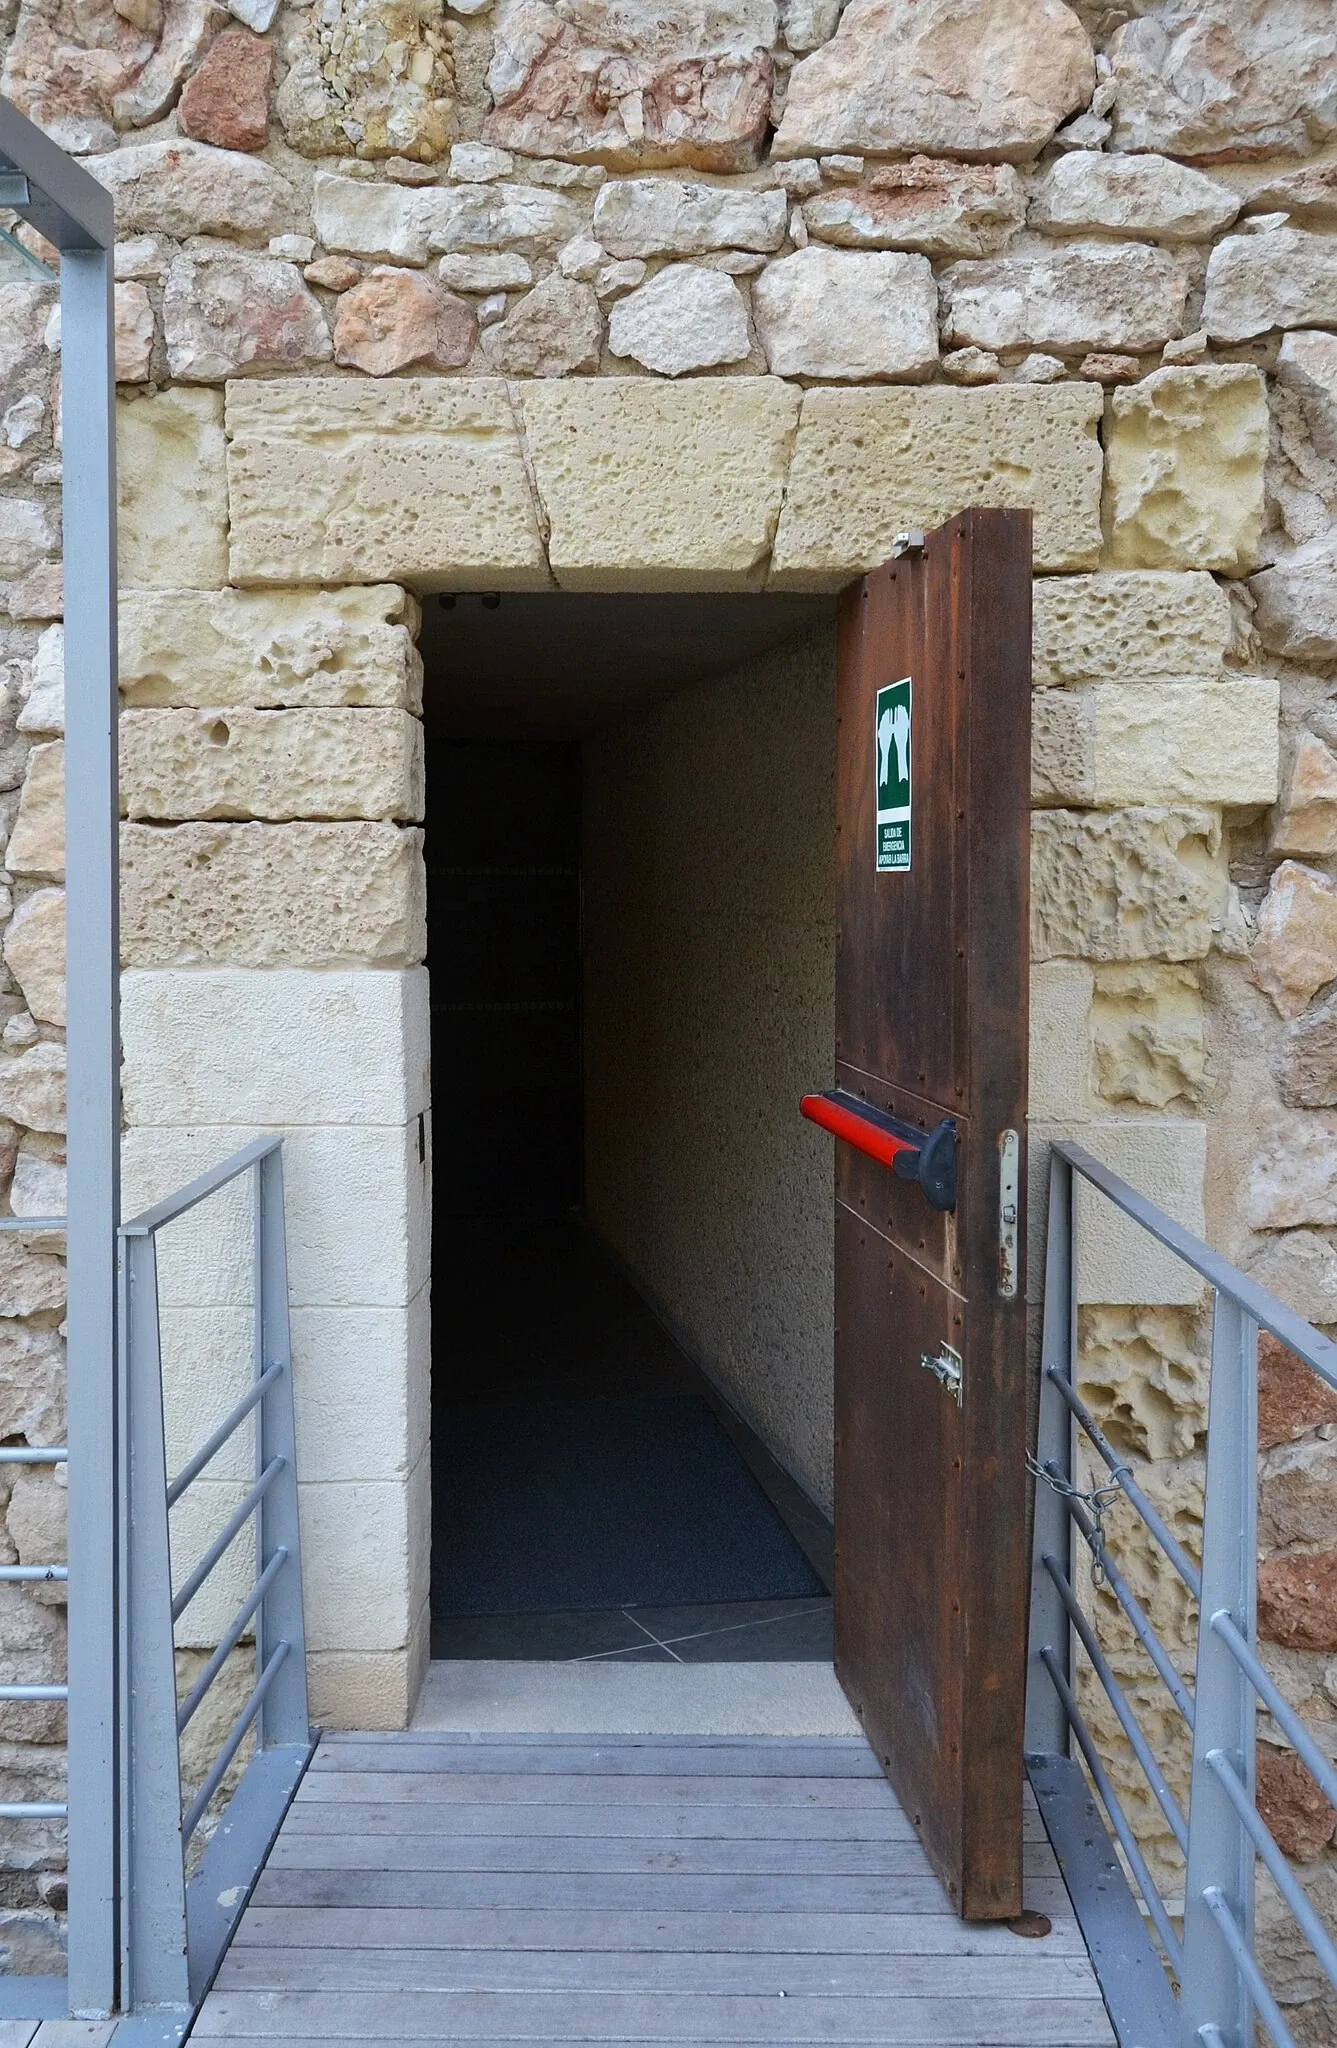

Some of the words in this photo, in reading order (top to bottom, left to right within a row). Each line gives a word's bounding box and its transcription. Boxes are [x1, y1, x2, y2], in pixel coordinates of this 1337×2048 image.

[884, 827, 896, 839] SALIDA
[896, 827, 902, 837] DE
[882, 840, 905, 852] EMERGENCIA
